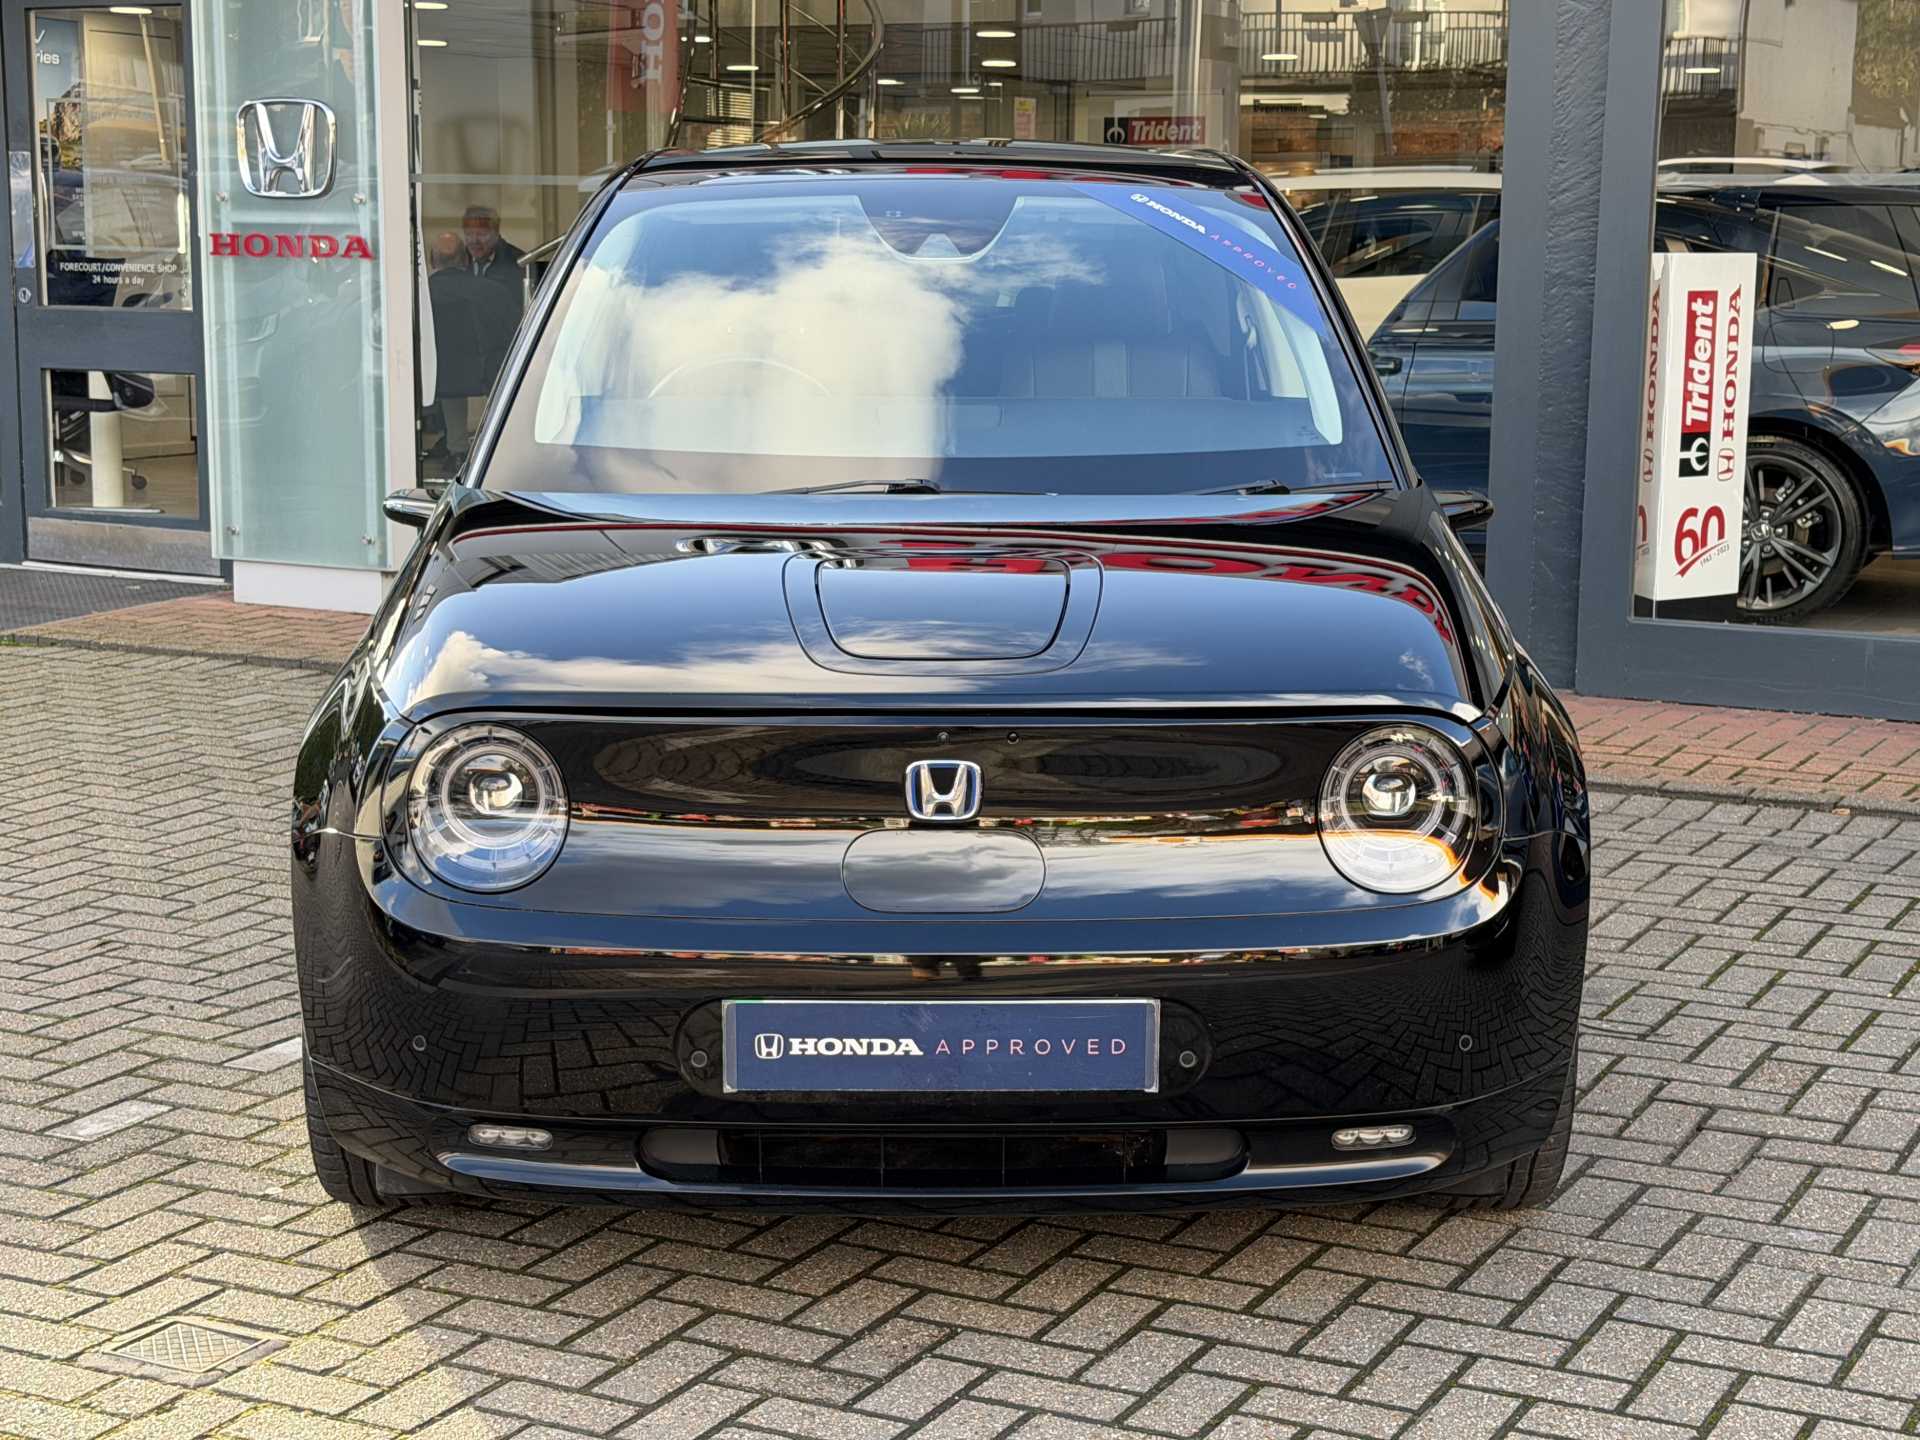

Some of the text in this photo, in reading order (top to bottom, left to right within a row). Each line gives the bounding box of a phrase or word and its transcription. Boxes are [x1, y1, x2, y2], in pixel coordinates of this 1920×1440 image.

[1131, 120, 1200, 141] Trident
[209, 233, 374, 259] HONDA
[1146, 200, 1296, 288] HONDA APPROVED
[103, 274, 122, 284] hours
[131, 276, 144, 287] day
[158, 263, 177, 273] SHOP
[1646, 285, 1660, 441] HONDA
[1686, 297, 1714, 426] Trident
[1722, 284, 1742, 441] HONDA
[789, 1038, 923, 1056] HONDA
[935, 1037, 1126, 1056] APPROVED
